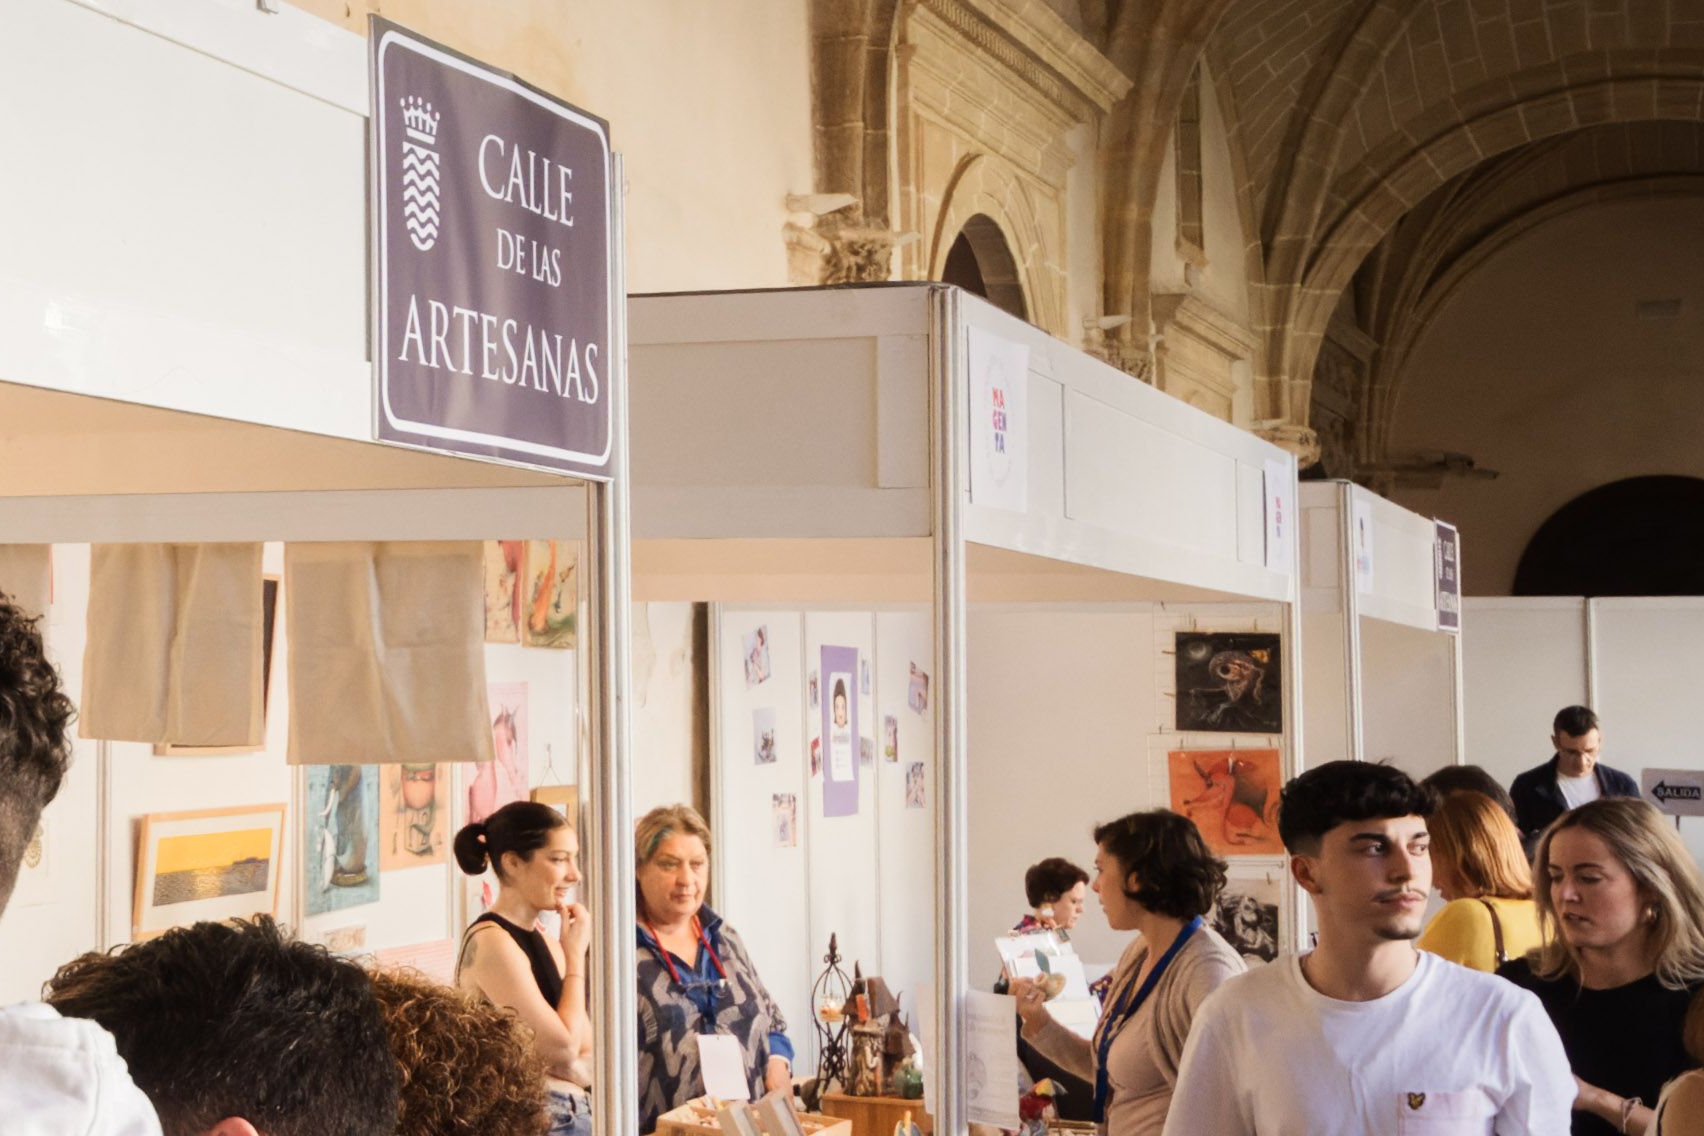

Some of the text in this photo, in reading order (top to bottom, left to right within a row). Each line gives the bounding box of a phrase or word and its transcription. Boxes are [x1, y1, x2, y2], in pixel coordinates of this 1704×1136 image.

[478, 133, 574, 228] CALLE
[496, 228, 561, 288] DE LAS
[398, 294, 599, 405] ARTESANAS
[1656, 786, 1700, 798] SALIDA
